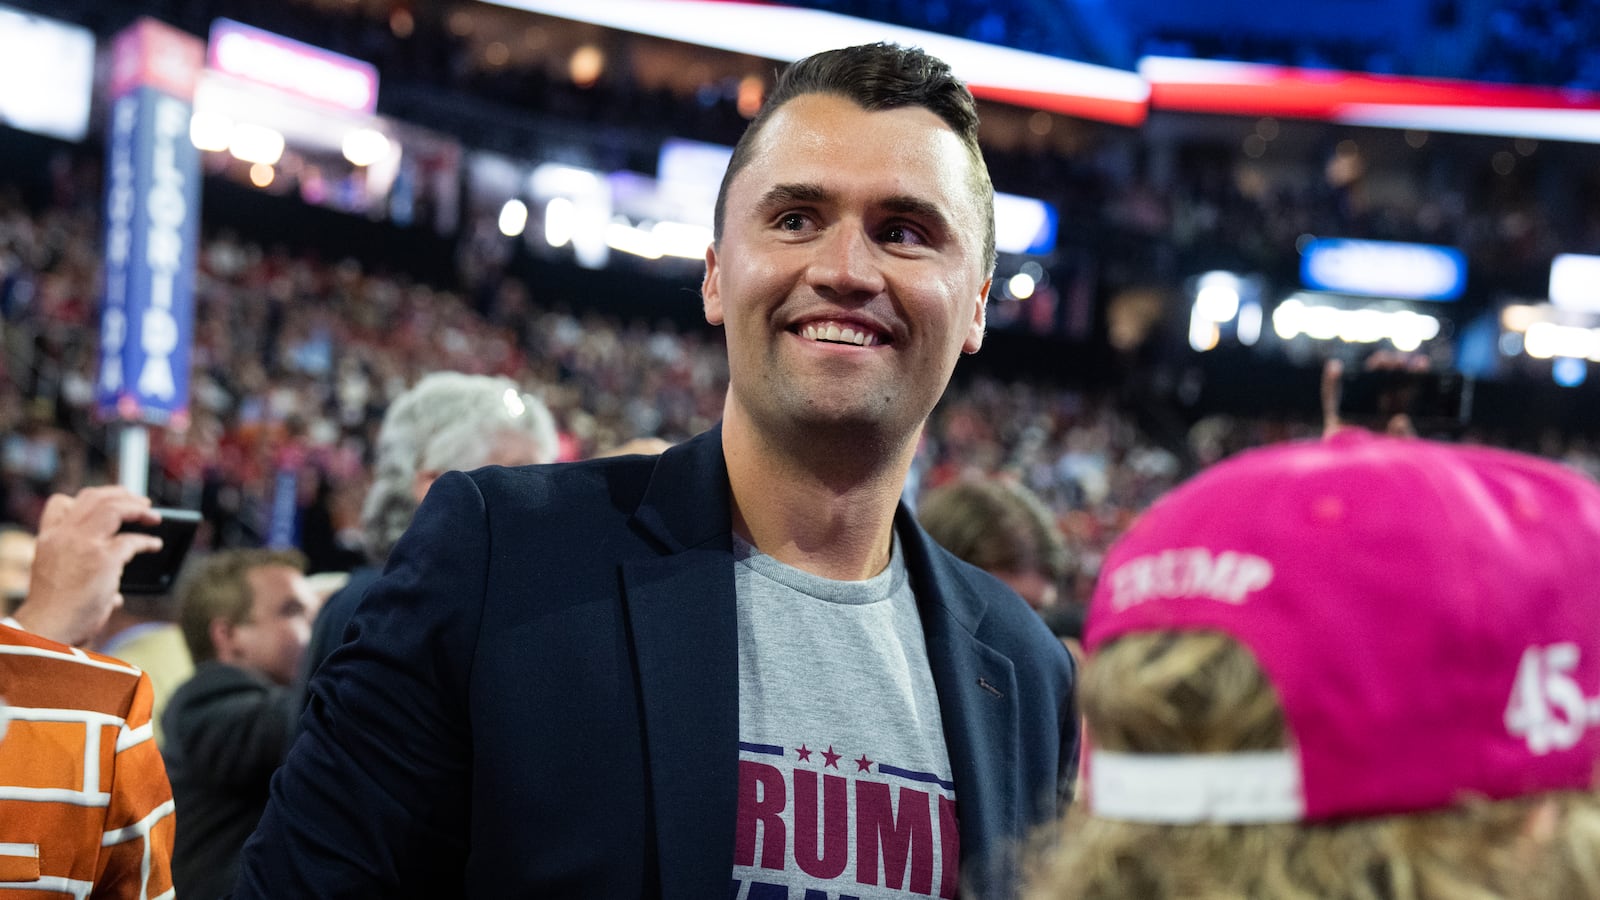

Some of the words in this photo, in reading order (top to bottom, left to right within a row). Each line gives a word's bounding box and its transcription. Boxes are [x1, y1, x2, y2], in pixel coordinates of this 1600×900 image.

[138, 97, 187, 400] FLORIDA
[1110, 547, 1273, 612] TRUMP
[734, 760, 959, 900] RUM
